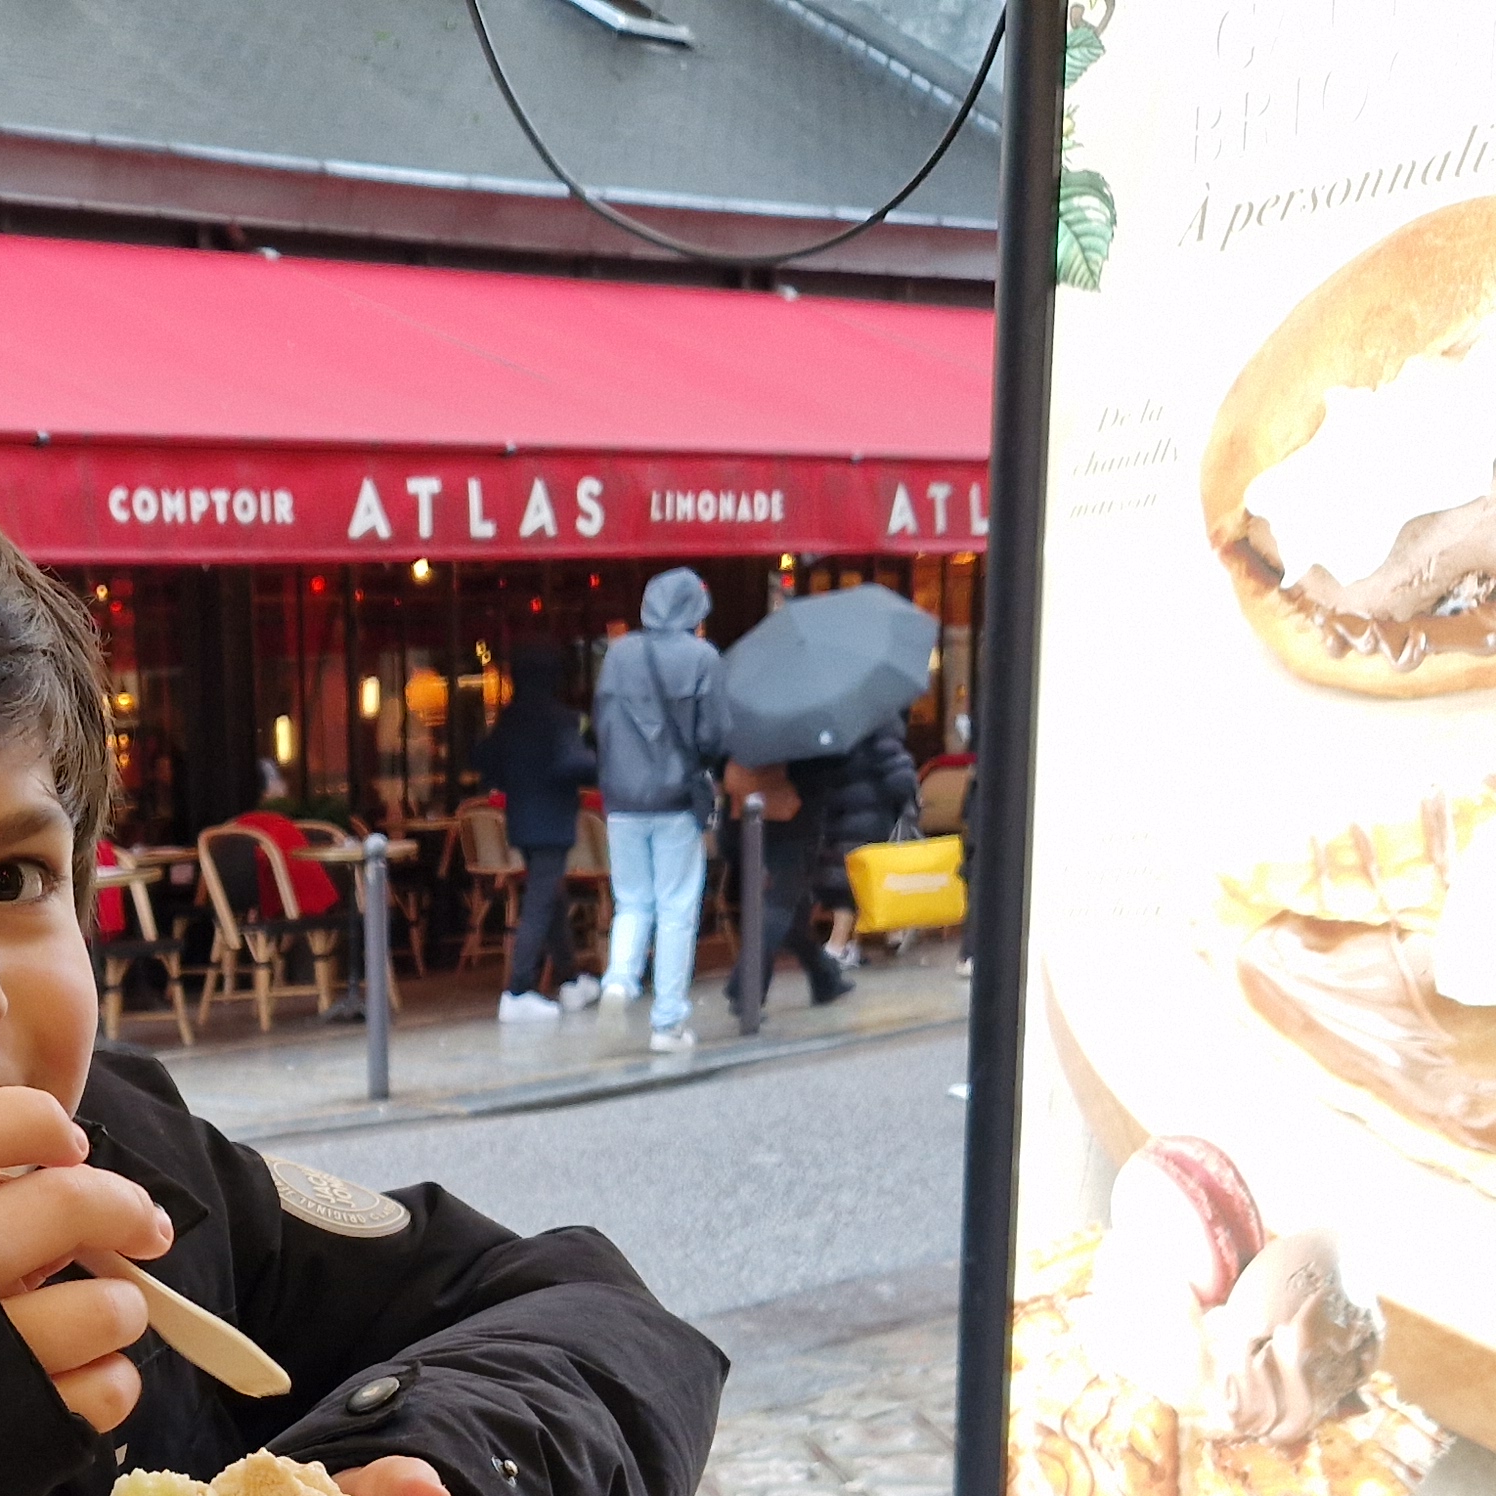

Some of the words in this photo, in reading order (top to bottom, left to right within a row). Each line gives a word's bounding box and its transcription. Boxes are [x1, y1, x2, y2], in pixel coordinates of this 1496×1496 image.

[1219, 123, 1496, 252] personnali
[107, 485, 295, 525] COMPTOIR
[347, 475, 605, 540] ATLAS
[649, 489, 785, 523] LIMONADE
[886, 481, 990, 537] ATL
[299, 1197, 366, 1224] ORIGINAL
